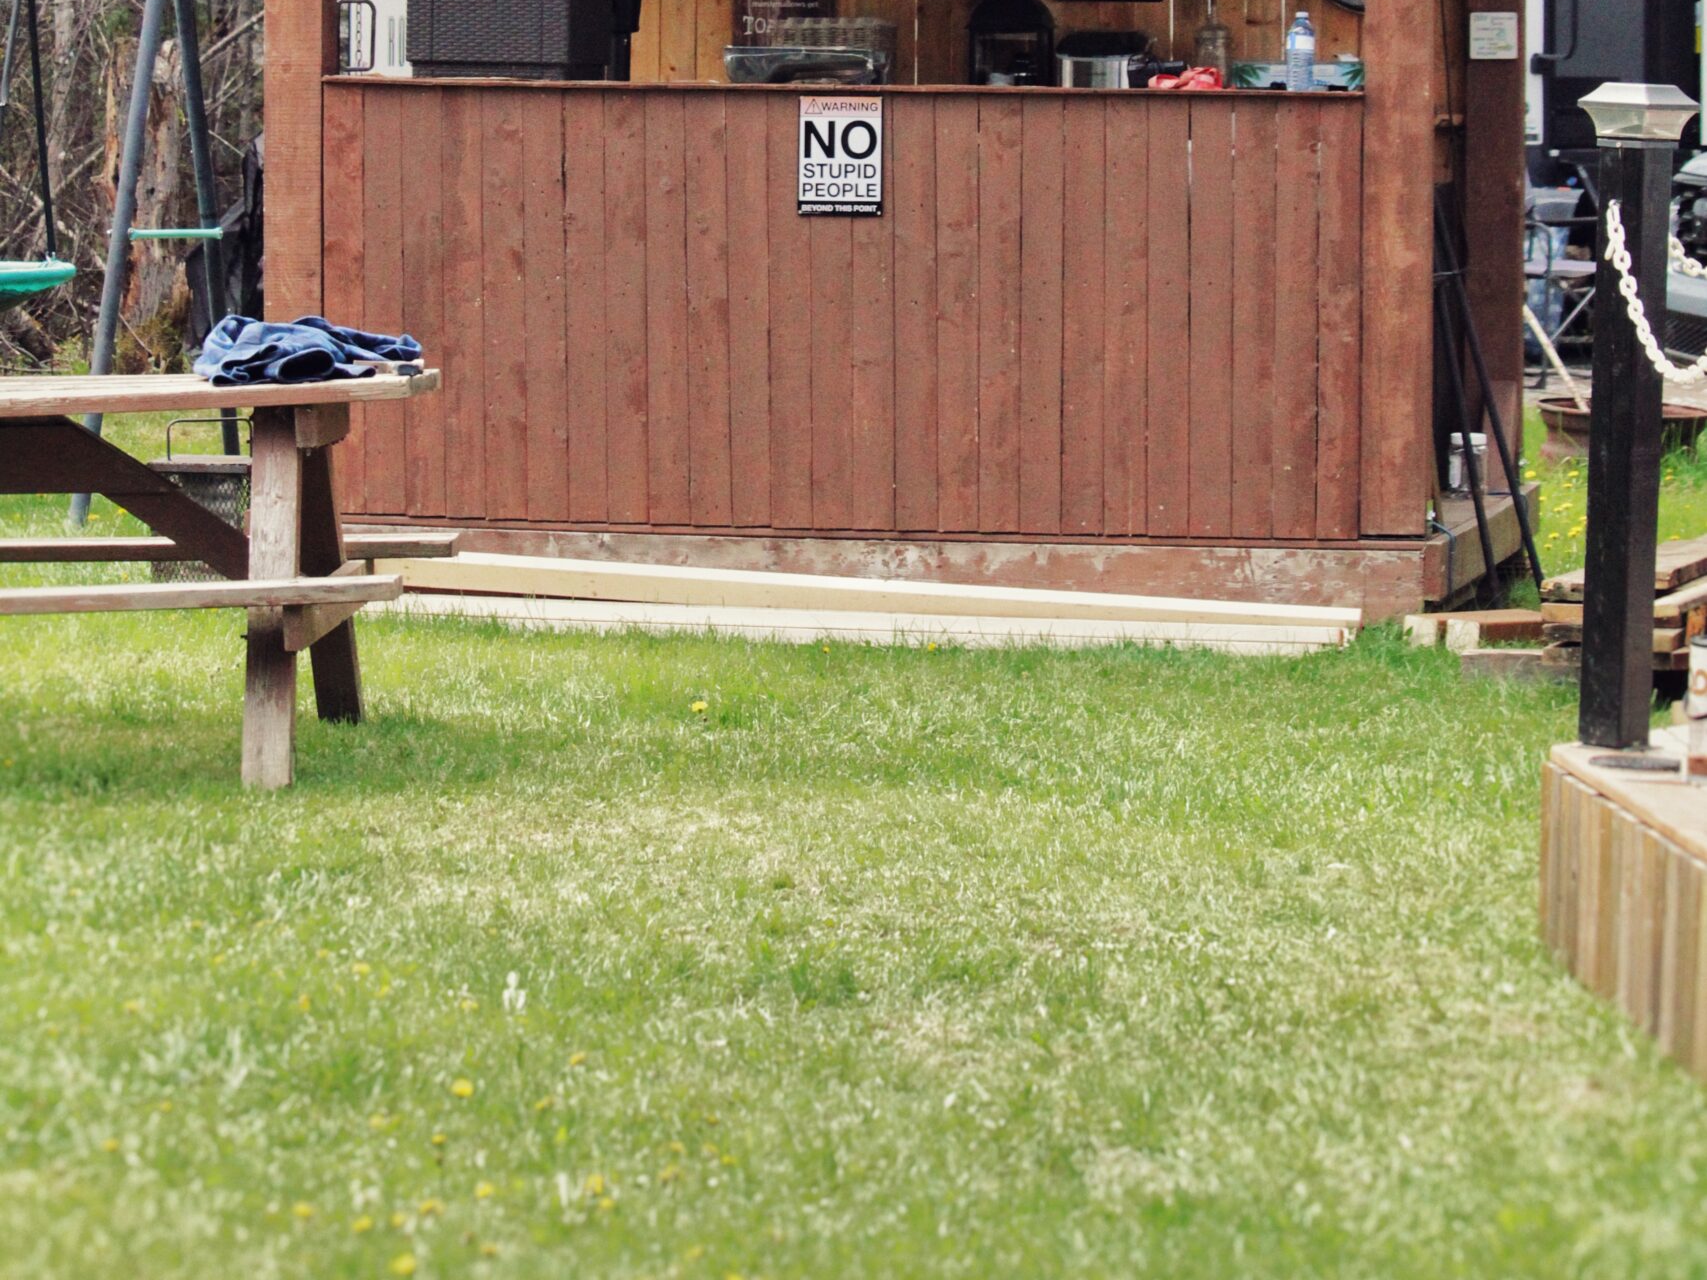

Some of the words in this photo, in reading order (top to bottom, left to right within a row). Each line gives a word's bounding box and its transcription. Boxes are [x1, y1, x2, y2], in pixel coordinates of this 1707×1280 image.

[822, 102, 878, 112] WARNING
[804, 120, 877, 160] NO
[803, 163, 876, 179] STUPID
[802, 183, 877, 198] PEOPLE
[801, 204, 834, 212] BEYOND
[835, 204, 852, 212] THIS
[853, 204, 877, 212] POINT
